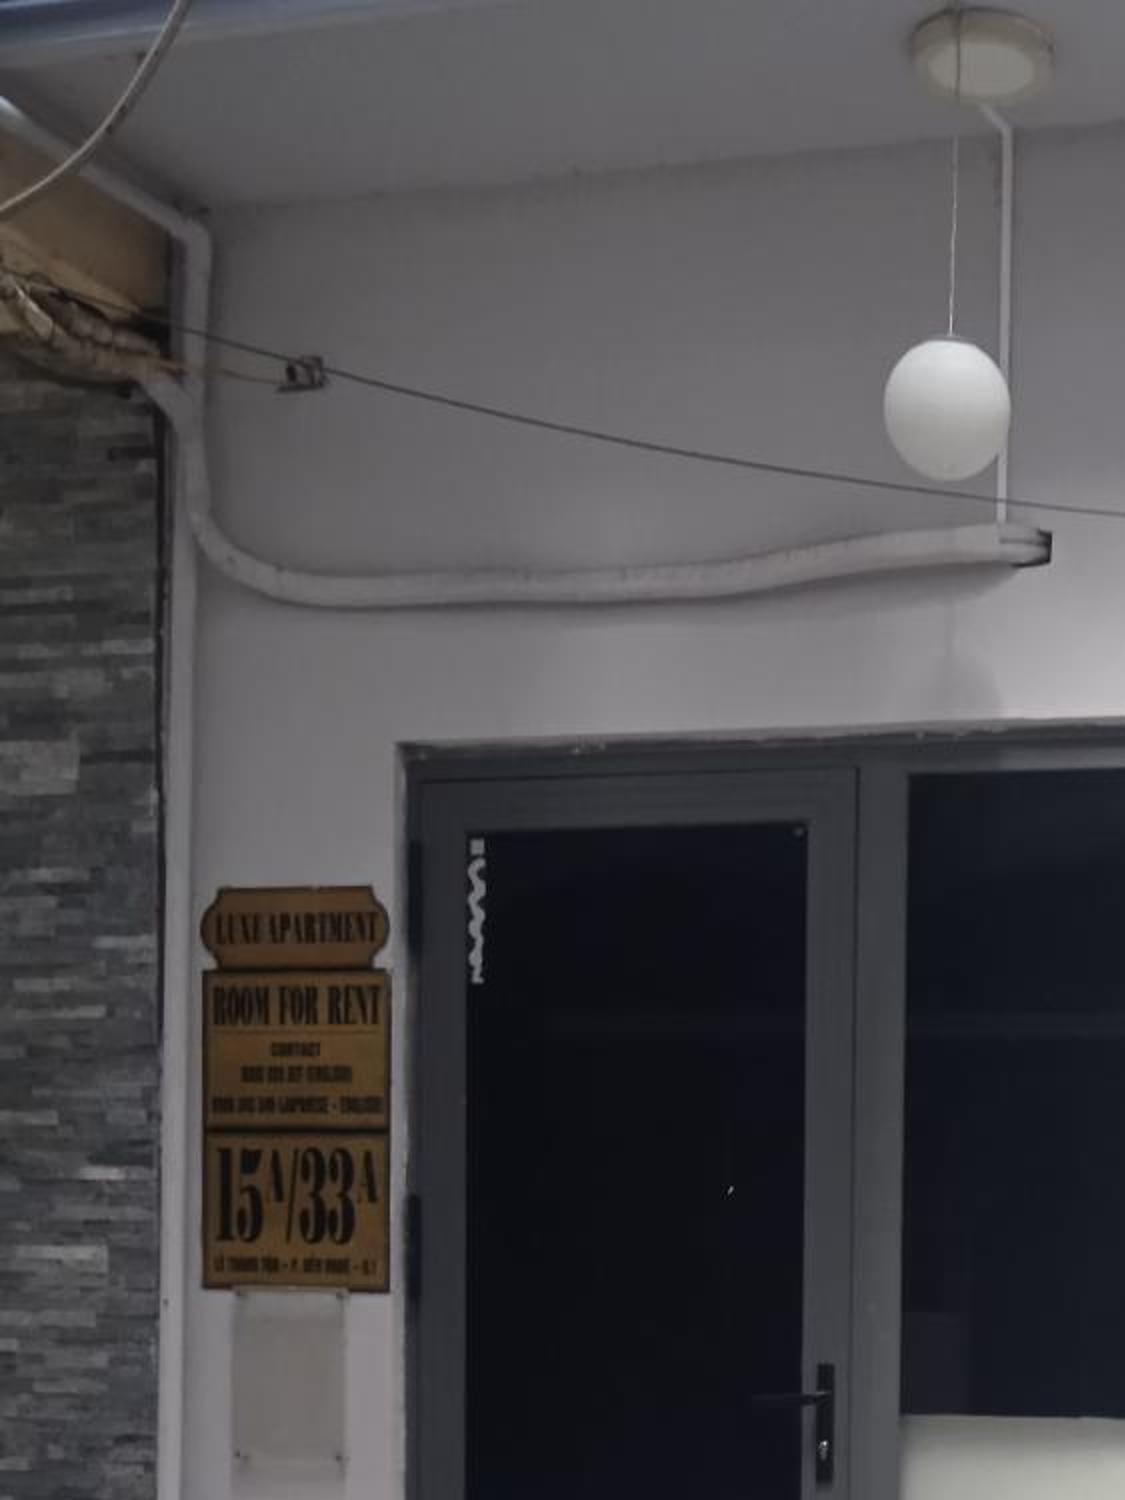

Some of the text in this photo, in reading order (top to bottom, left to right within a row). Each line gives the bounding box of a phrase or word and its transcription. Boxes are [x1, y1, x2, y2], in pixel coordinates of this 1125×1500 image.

[268, 911, 379, 945] APARTMENT
[213, 985, 380, 1026] ROOM FOR RENT
